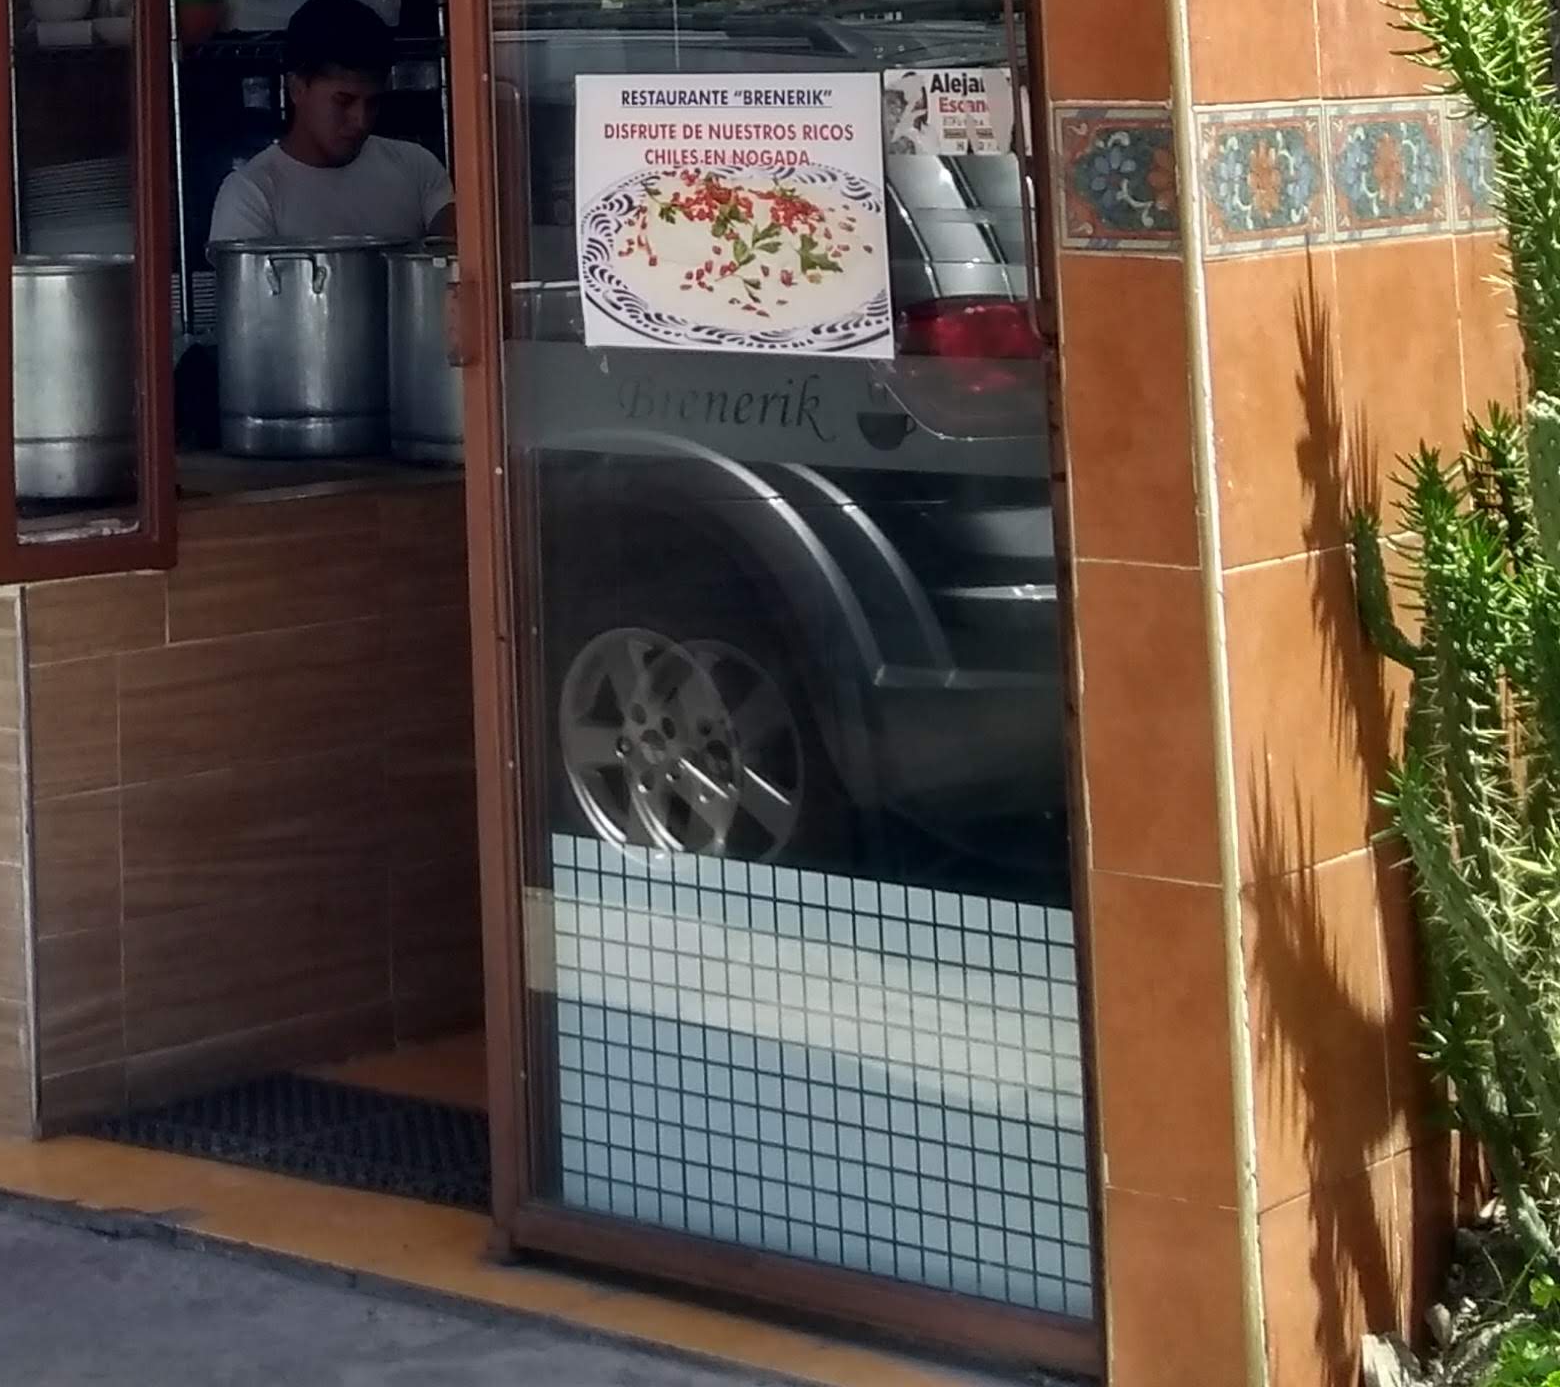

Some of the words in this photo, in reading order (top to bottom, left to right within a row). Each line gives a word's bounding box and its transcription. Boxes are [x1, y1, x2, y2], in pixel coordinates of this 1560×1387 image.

[621, 89, 729, 106] RESTAURANTE
[734, 89, 833, 106] “BRENERIK”
[604, 123, 677, 140] DISFRUTE
[683, 123, 703, 140] DE
[708, 124, 797, 141] NUESTROS
[802, 124, 854, 142] RICOS
[704, 149, 726, 166] EN
[732, 149, 810, 167] NOGADA
[616, 374, 839, 443] Brenerik
